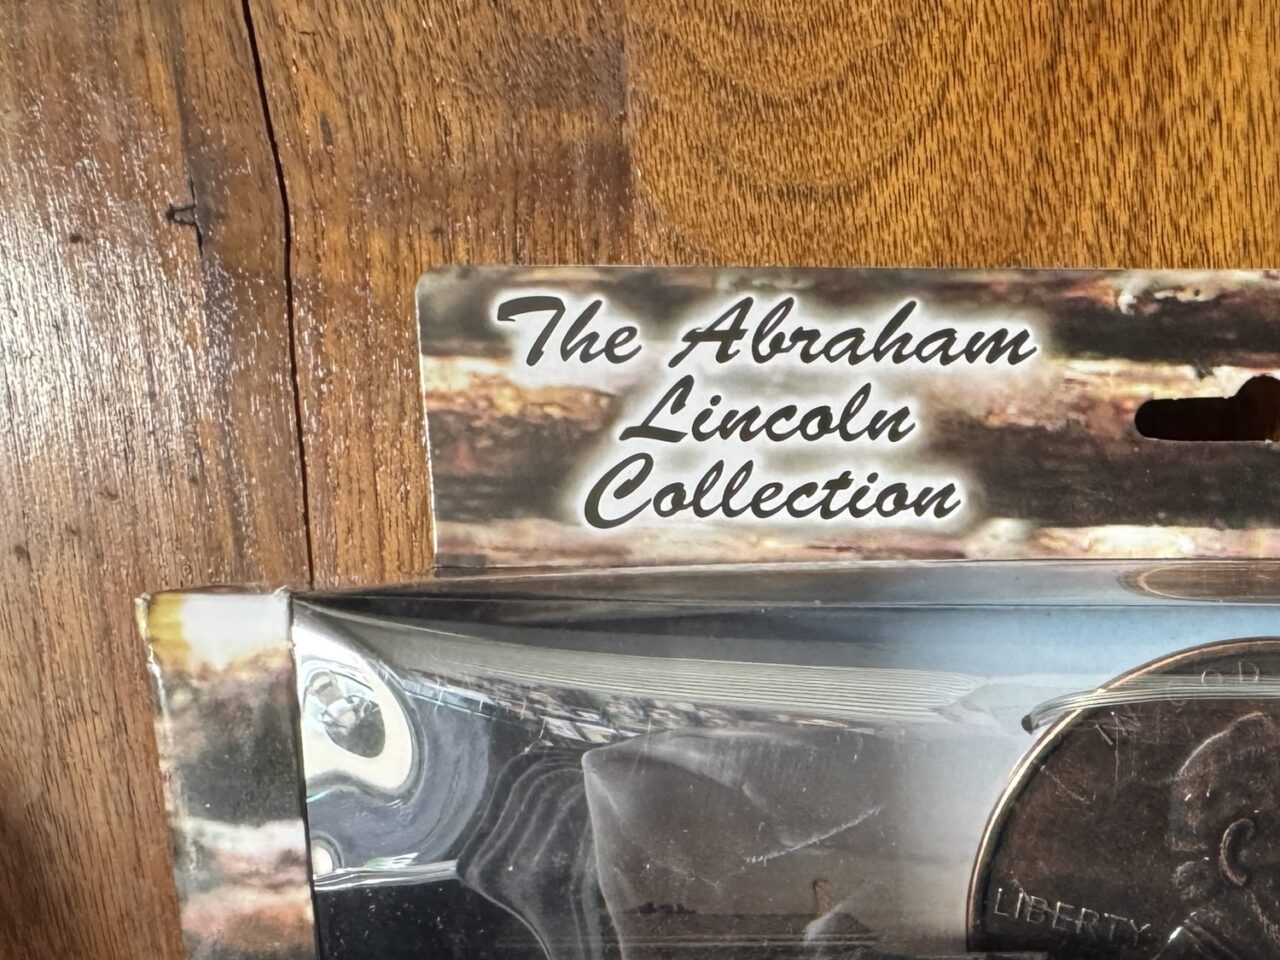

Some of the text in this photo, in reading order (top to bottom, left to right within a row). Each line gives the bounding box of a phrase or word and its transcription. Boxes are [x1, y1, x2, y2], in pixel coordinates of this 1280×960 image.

[497, 295, 1038, 367] The Abraham
[618, 374, 916, 443] Lincoln
[583, 451, 962, 530] Collection
[994, 887, 1151, 946] LIBERTY
